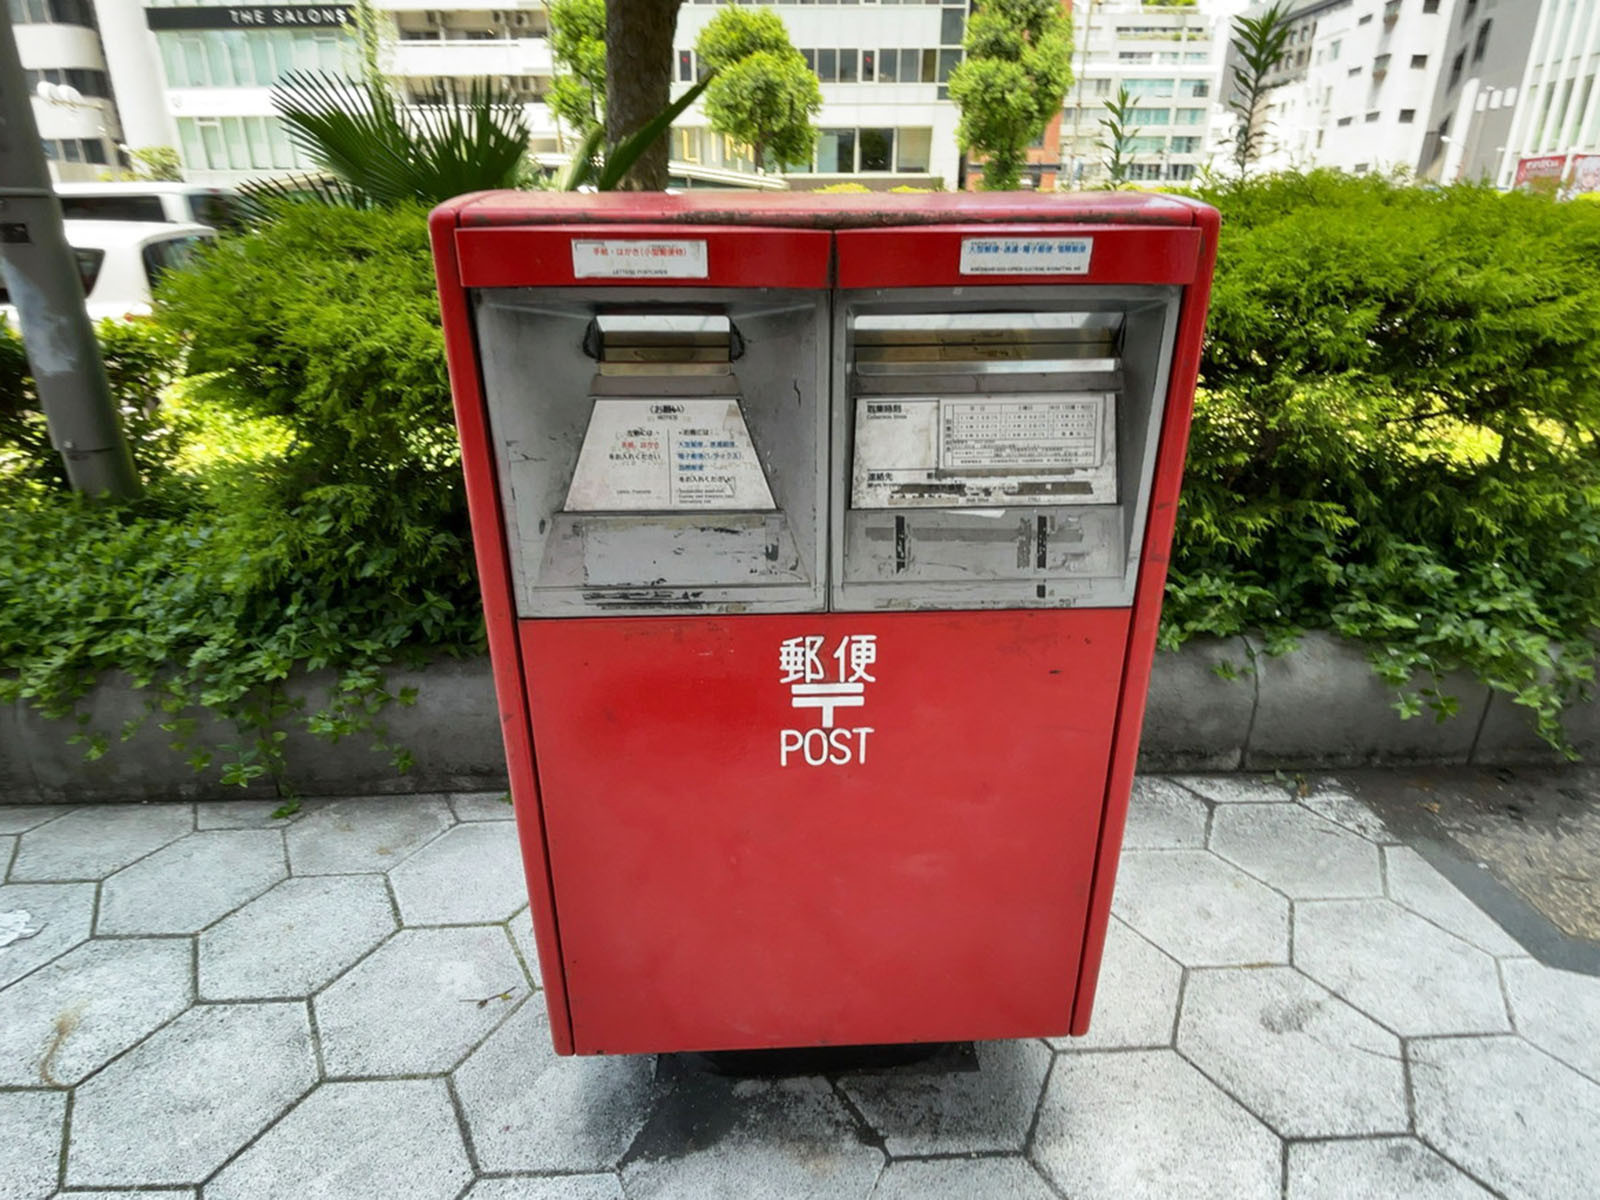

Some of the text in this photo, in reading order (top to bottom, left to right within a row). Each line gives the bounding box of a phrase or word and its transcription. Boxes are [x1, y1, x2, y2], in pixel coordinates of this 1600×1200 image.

[229, 8, 347, 24] THE SALONS
[780, 635, 877, 683] 郵便
[780, 727, 875, 766] POST
